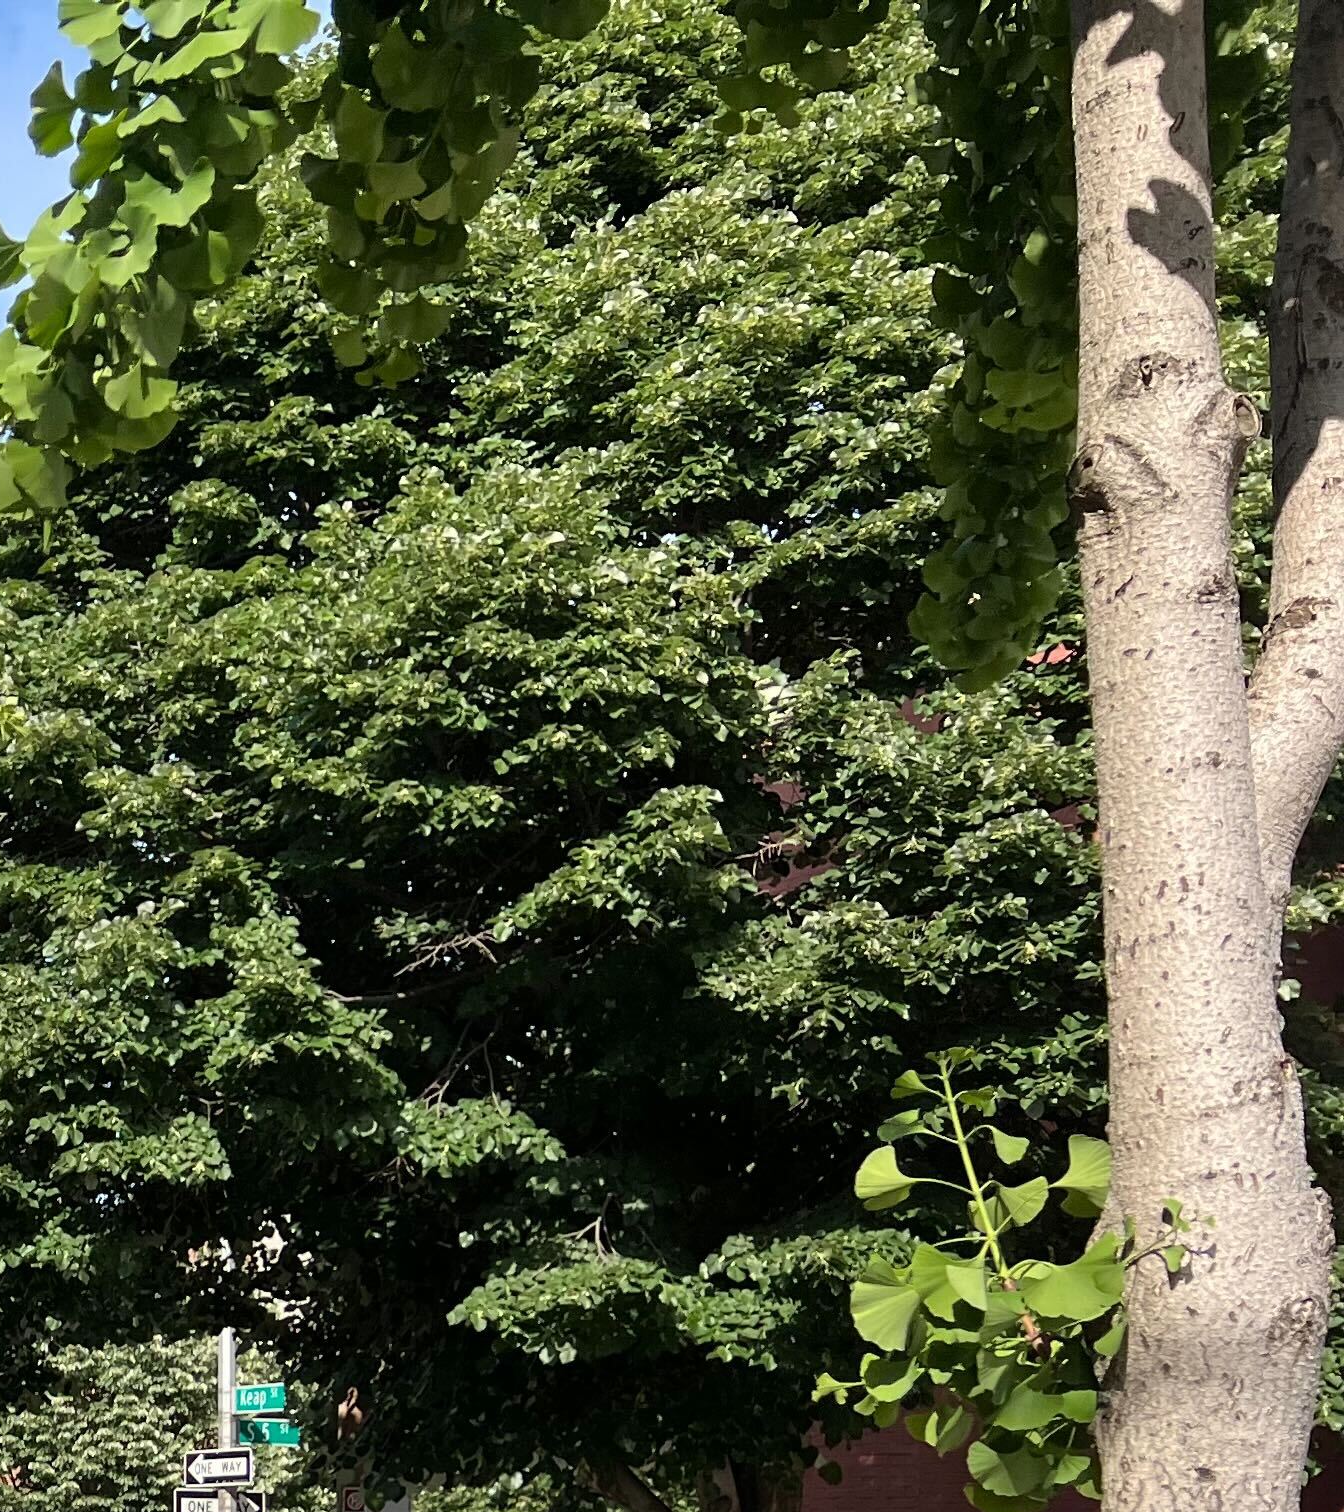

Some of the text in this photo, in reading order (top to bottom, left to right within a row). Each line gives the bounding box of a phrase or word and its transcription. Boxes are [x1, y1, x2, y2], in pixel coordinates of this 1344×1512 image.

[239, 1389, 267, 1408] Keap
[247, 1422, 255, 1442] S
[261, 1422, 270, 1442] 5
[194, 1461, 243, 1475] ONE WAY
